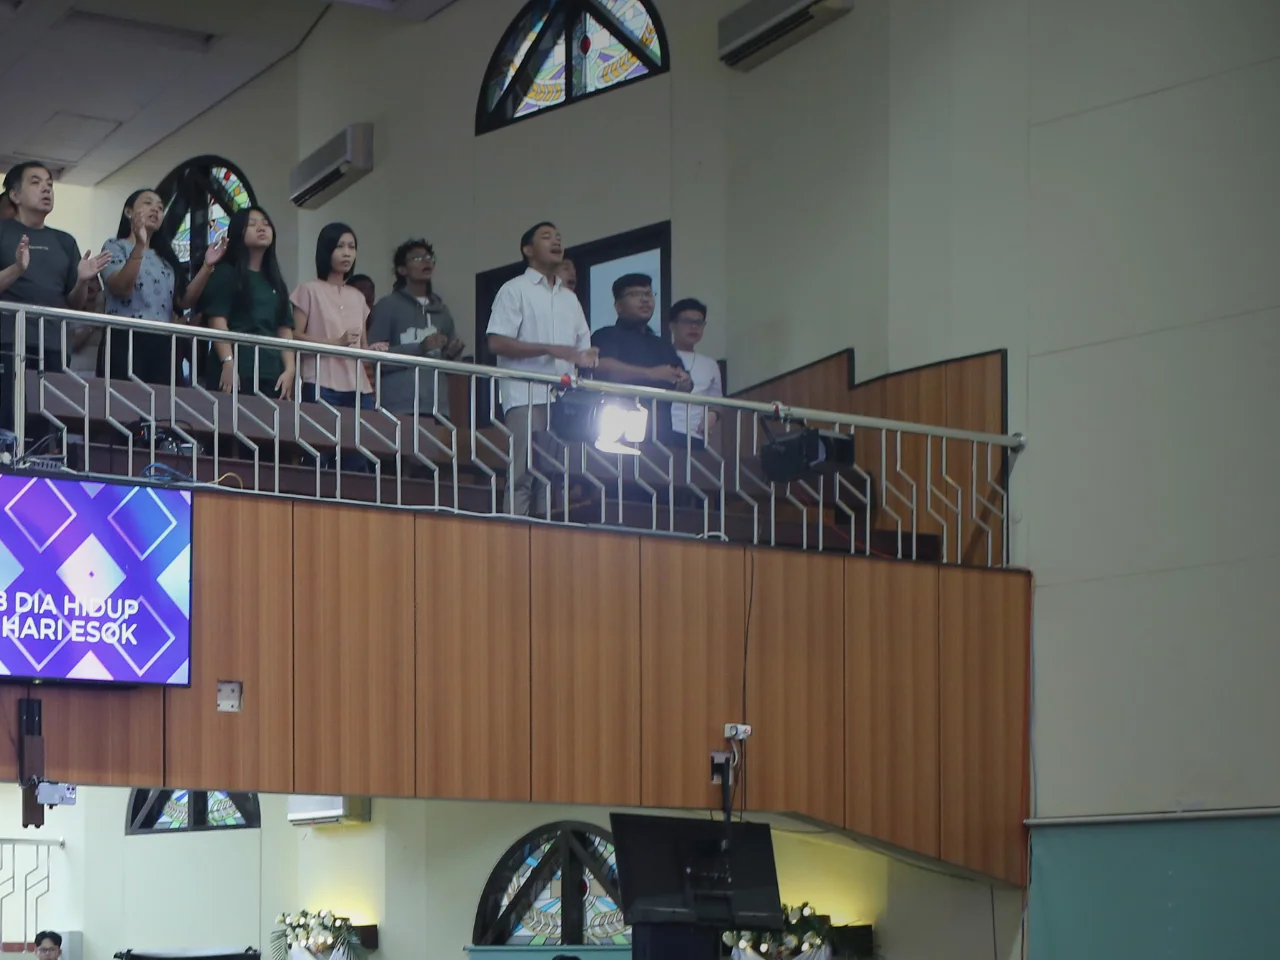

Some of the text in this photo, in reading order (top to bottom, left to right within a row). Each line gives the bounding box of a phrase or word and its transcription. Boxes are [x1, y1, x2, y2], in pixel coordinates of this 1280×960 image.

[15, 591, 58, 615] DIA
[63, 594, 139, 620] HIDUP
[2, 615, 63, 641] HARI
[71, 619, 138, 646] ESOK
